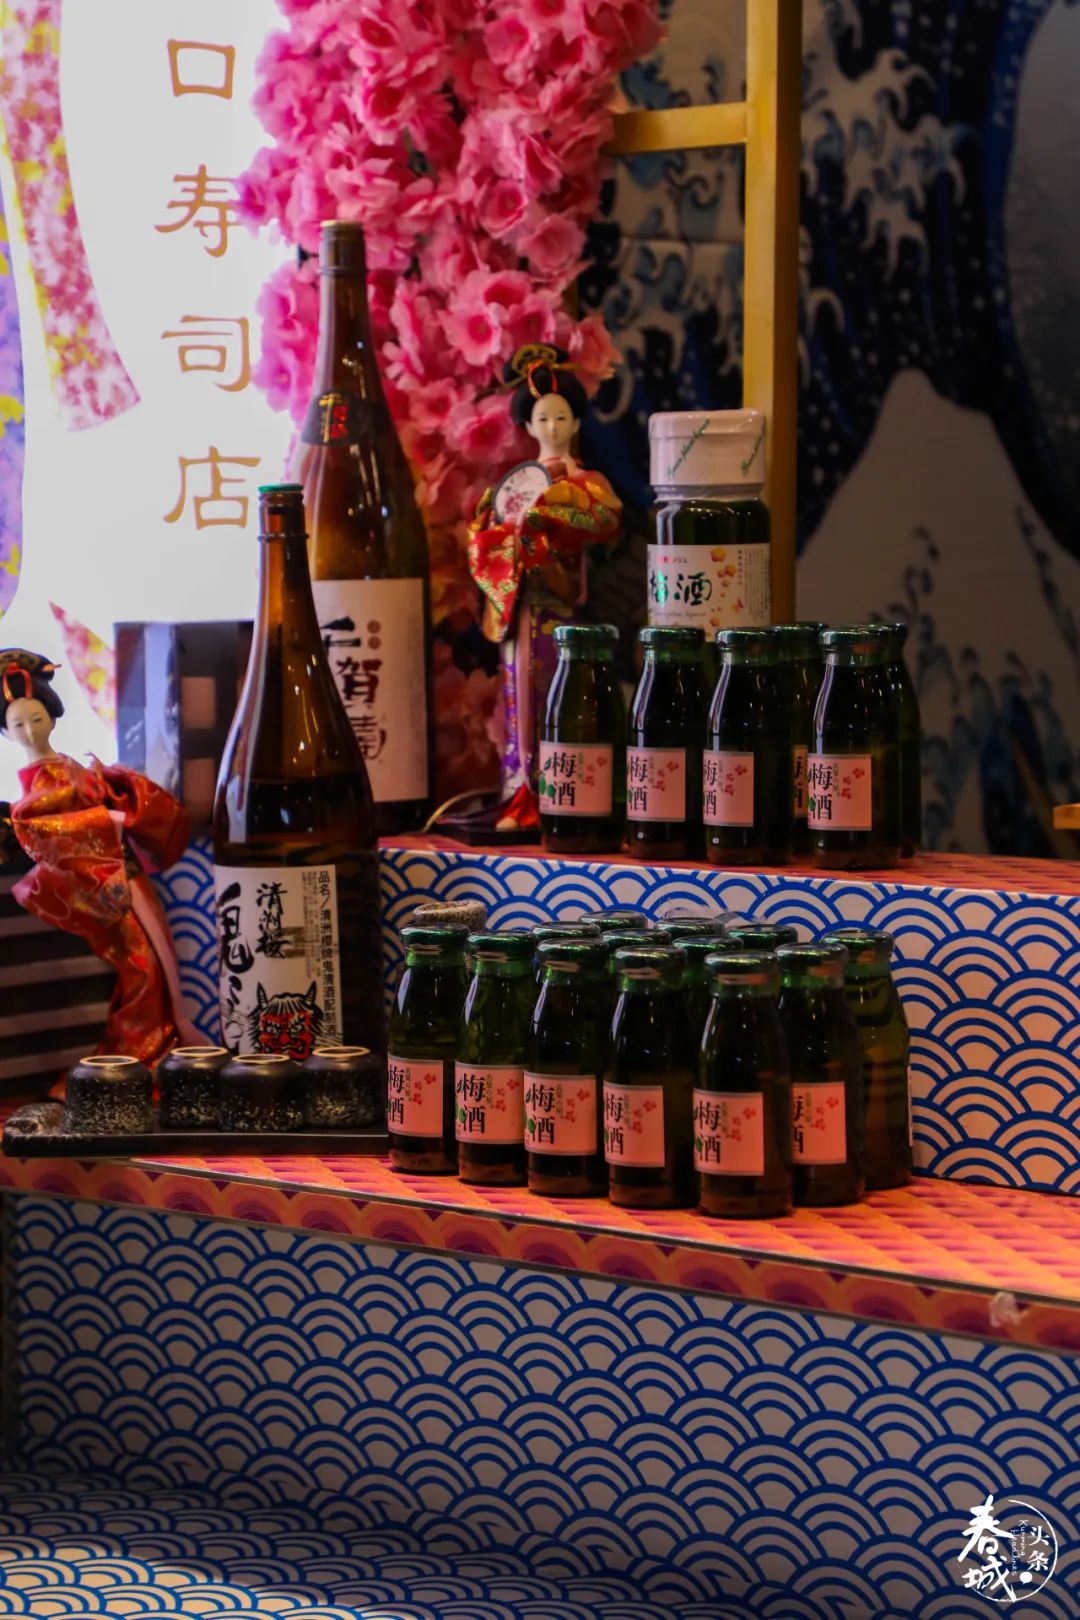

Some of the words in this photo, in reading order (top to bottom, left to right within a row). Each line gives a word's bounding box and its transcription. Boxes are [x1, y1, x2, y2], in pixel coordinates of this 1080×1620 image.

[551, 752, 577, 806] 梅酒
[630, 756, 648, 812] 梅酒
[703, 759, 718, 816] 梅酒
[811, 763, 833, 821] 梅酒
[388, 1065, 404, 1125] 梅酒
[462, 1073, 486, 1134] 梅酒
[531, 1083, 556, 1145] 梅酒
[605, 1092, 624, 1155] 梅酒
[700, 1101, 721, 1164] 梅酒
